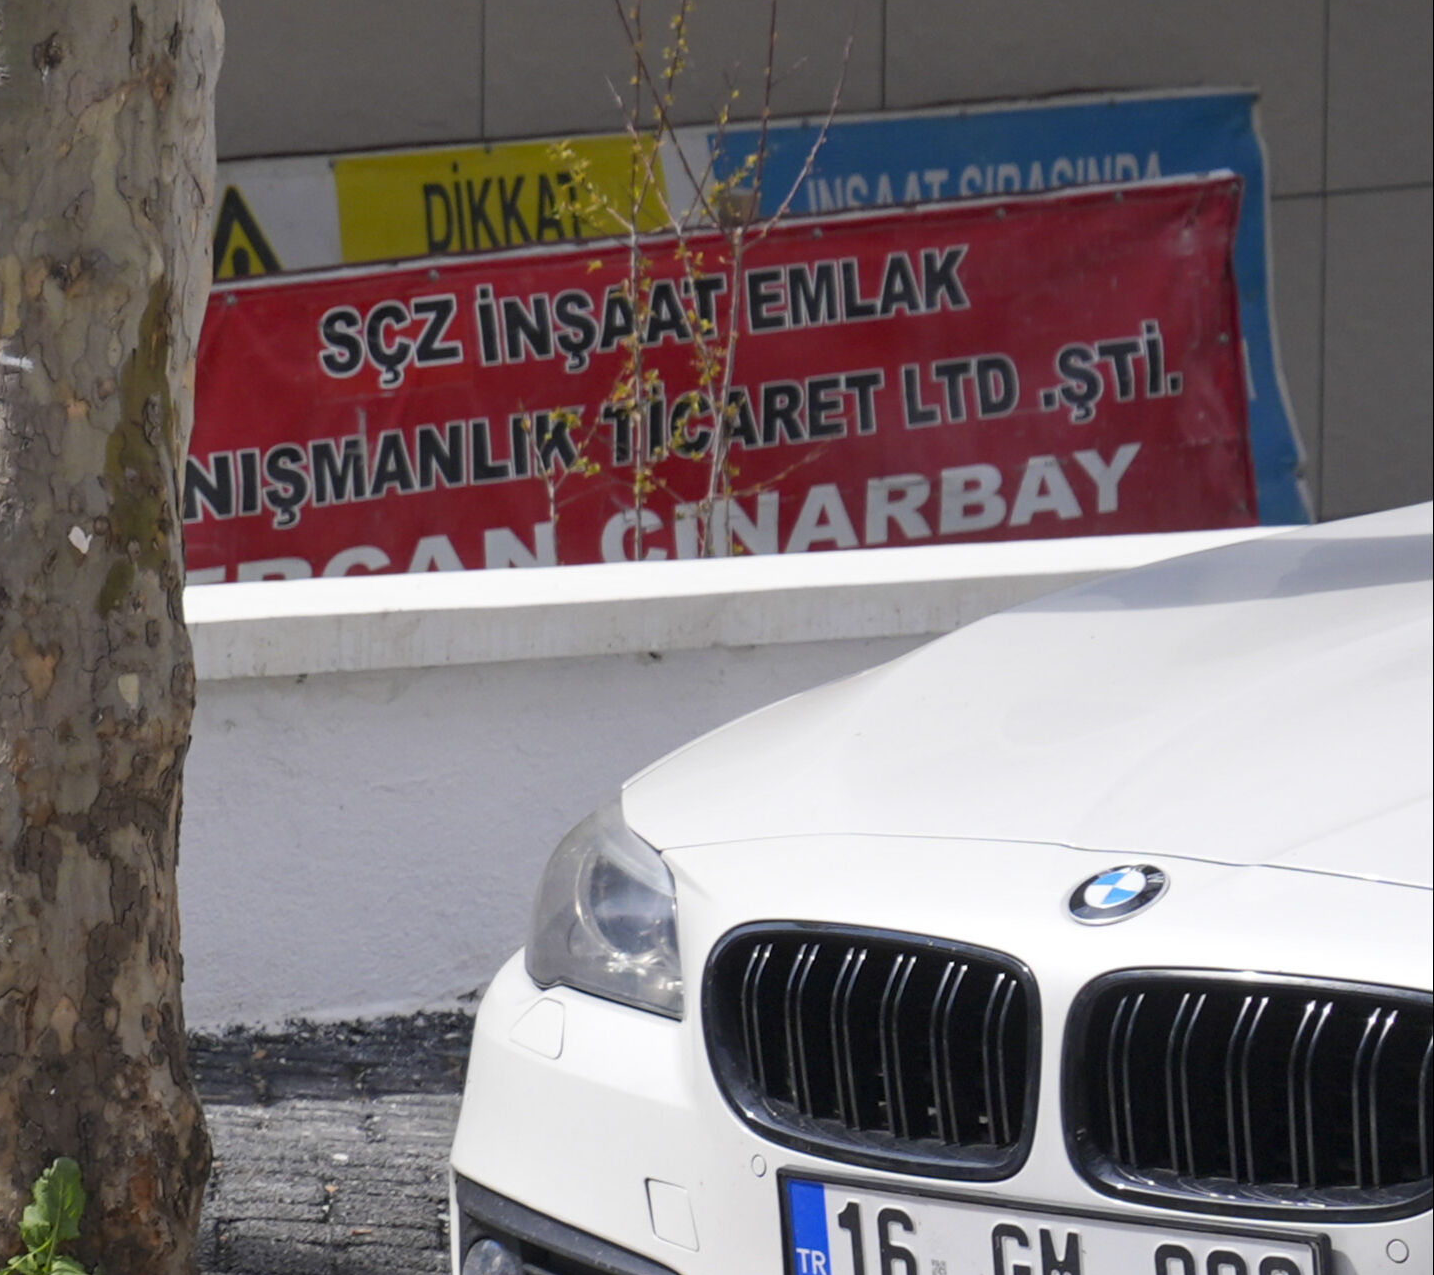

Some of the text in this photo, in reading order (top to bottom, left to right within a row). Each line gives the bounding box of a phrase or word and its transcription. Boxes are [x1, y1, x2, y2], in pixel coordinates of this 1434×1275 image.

[319, 244, 971, 388] SÇZ İNŞAAT EMLAK
[186, 402, 586, 529] NIŞMANLIK
[604, 368, 883, 467] TİCARET
[902, 353, 1021, 426] LTD
